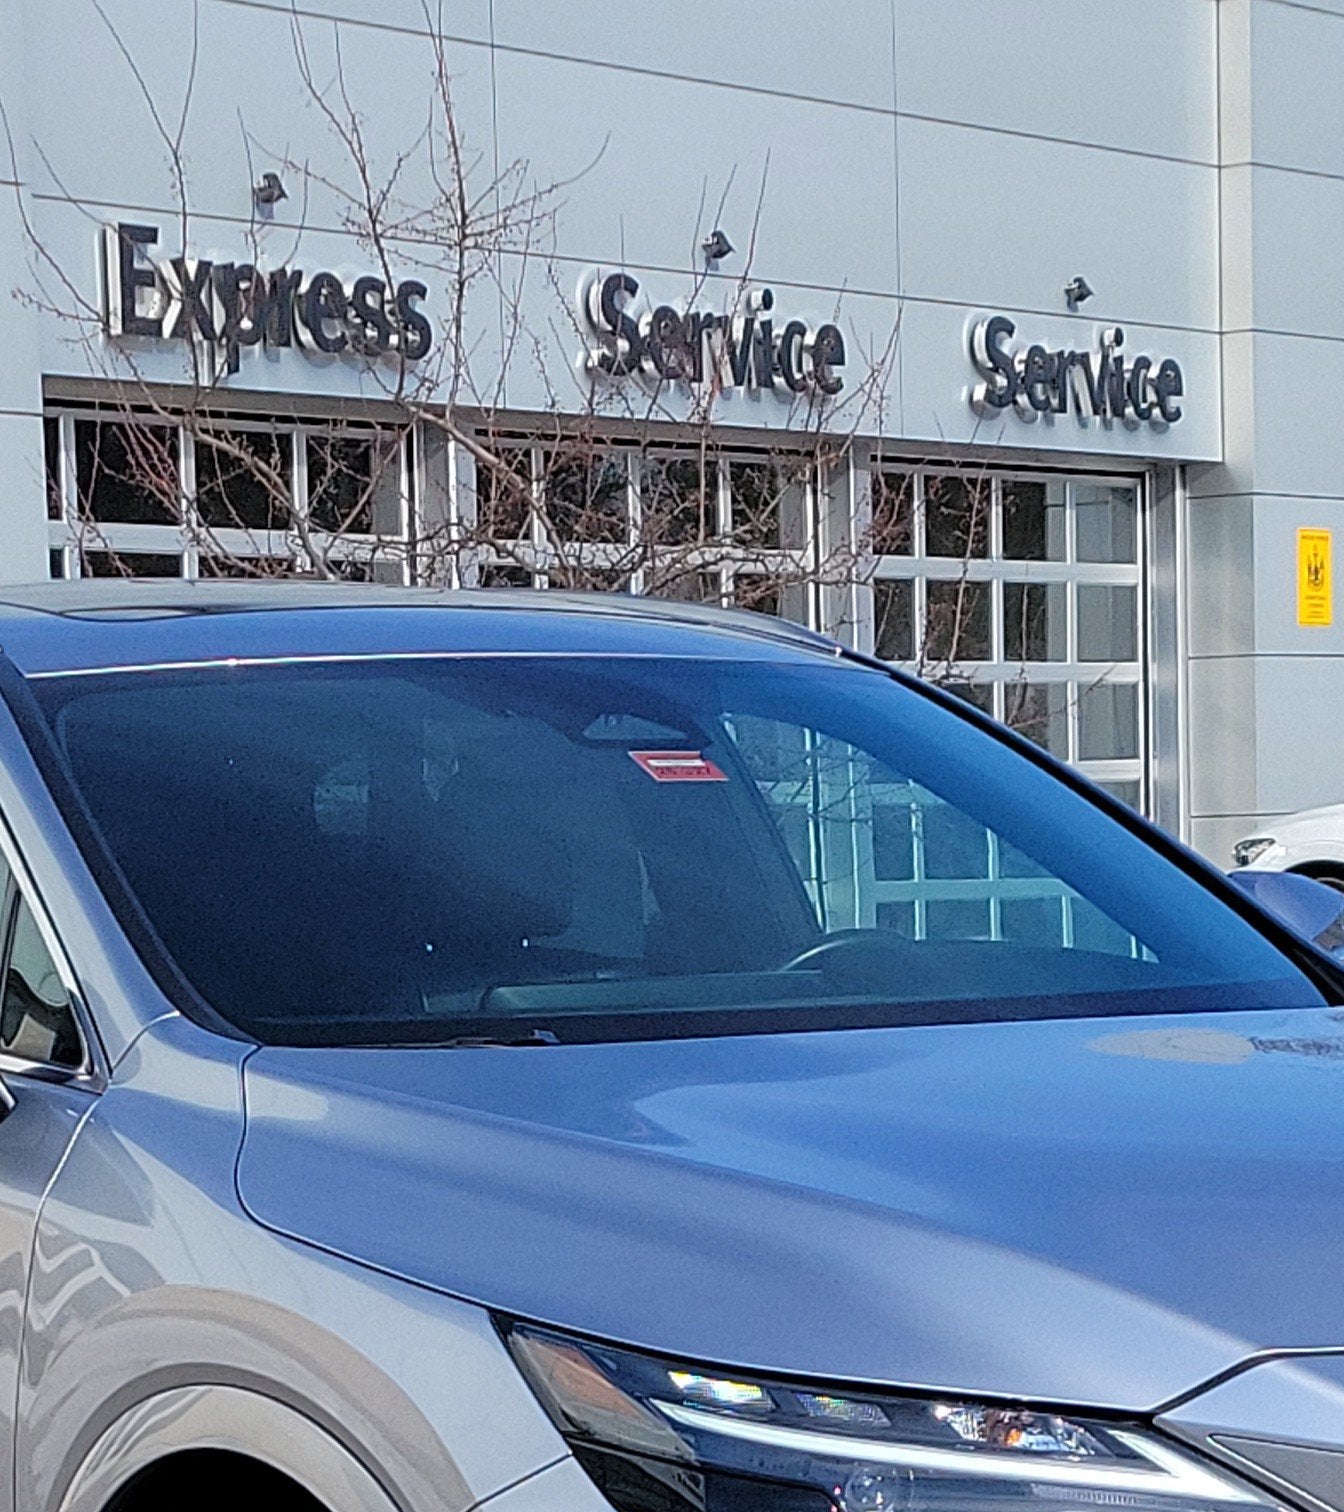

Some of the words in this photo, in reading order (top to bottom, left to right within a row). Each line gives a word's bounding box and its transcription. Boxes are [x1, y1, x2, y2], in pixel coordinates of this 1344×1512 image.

[102, 222, 433, 375] Express
[585, 273, 846, 396] Service
[969, 315, 1183, 424] Service
